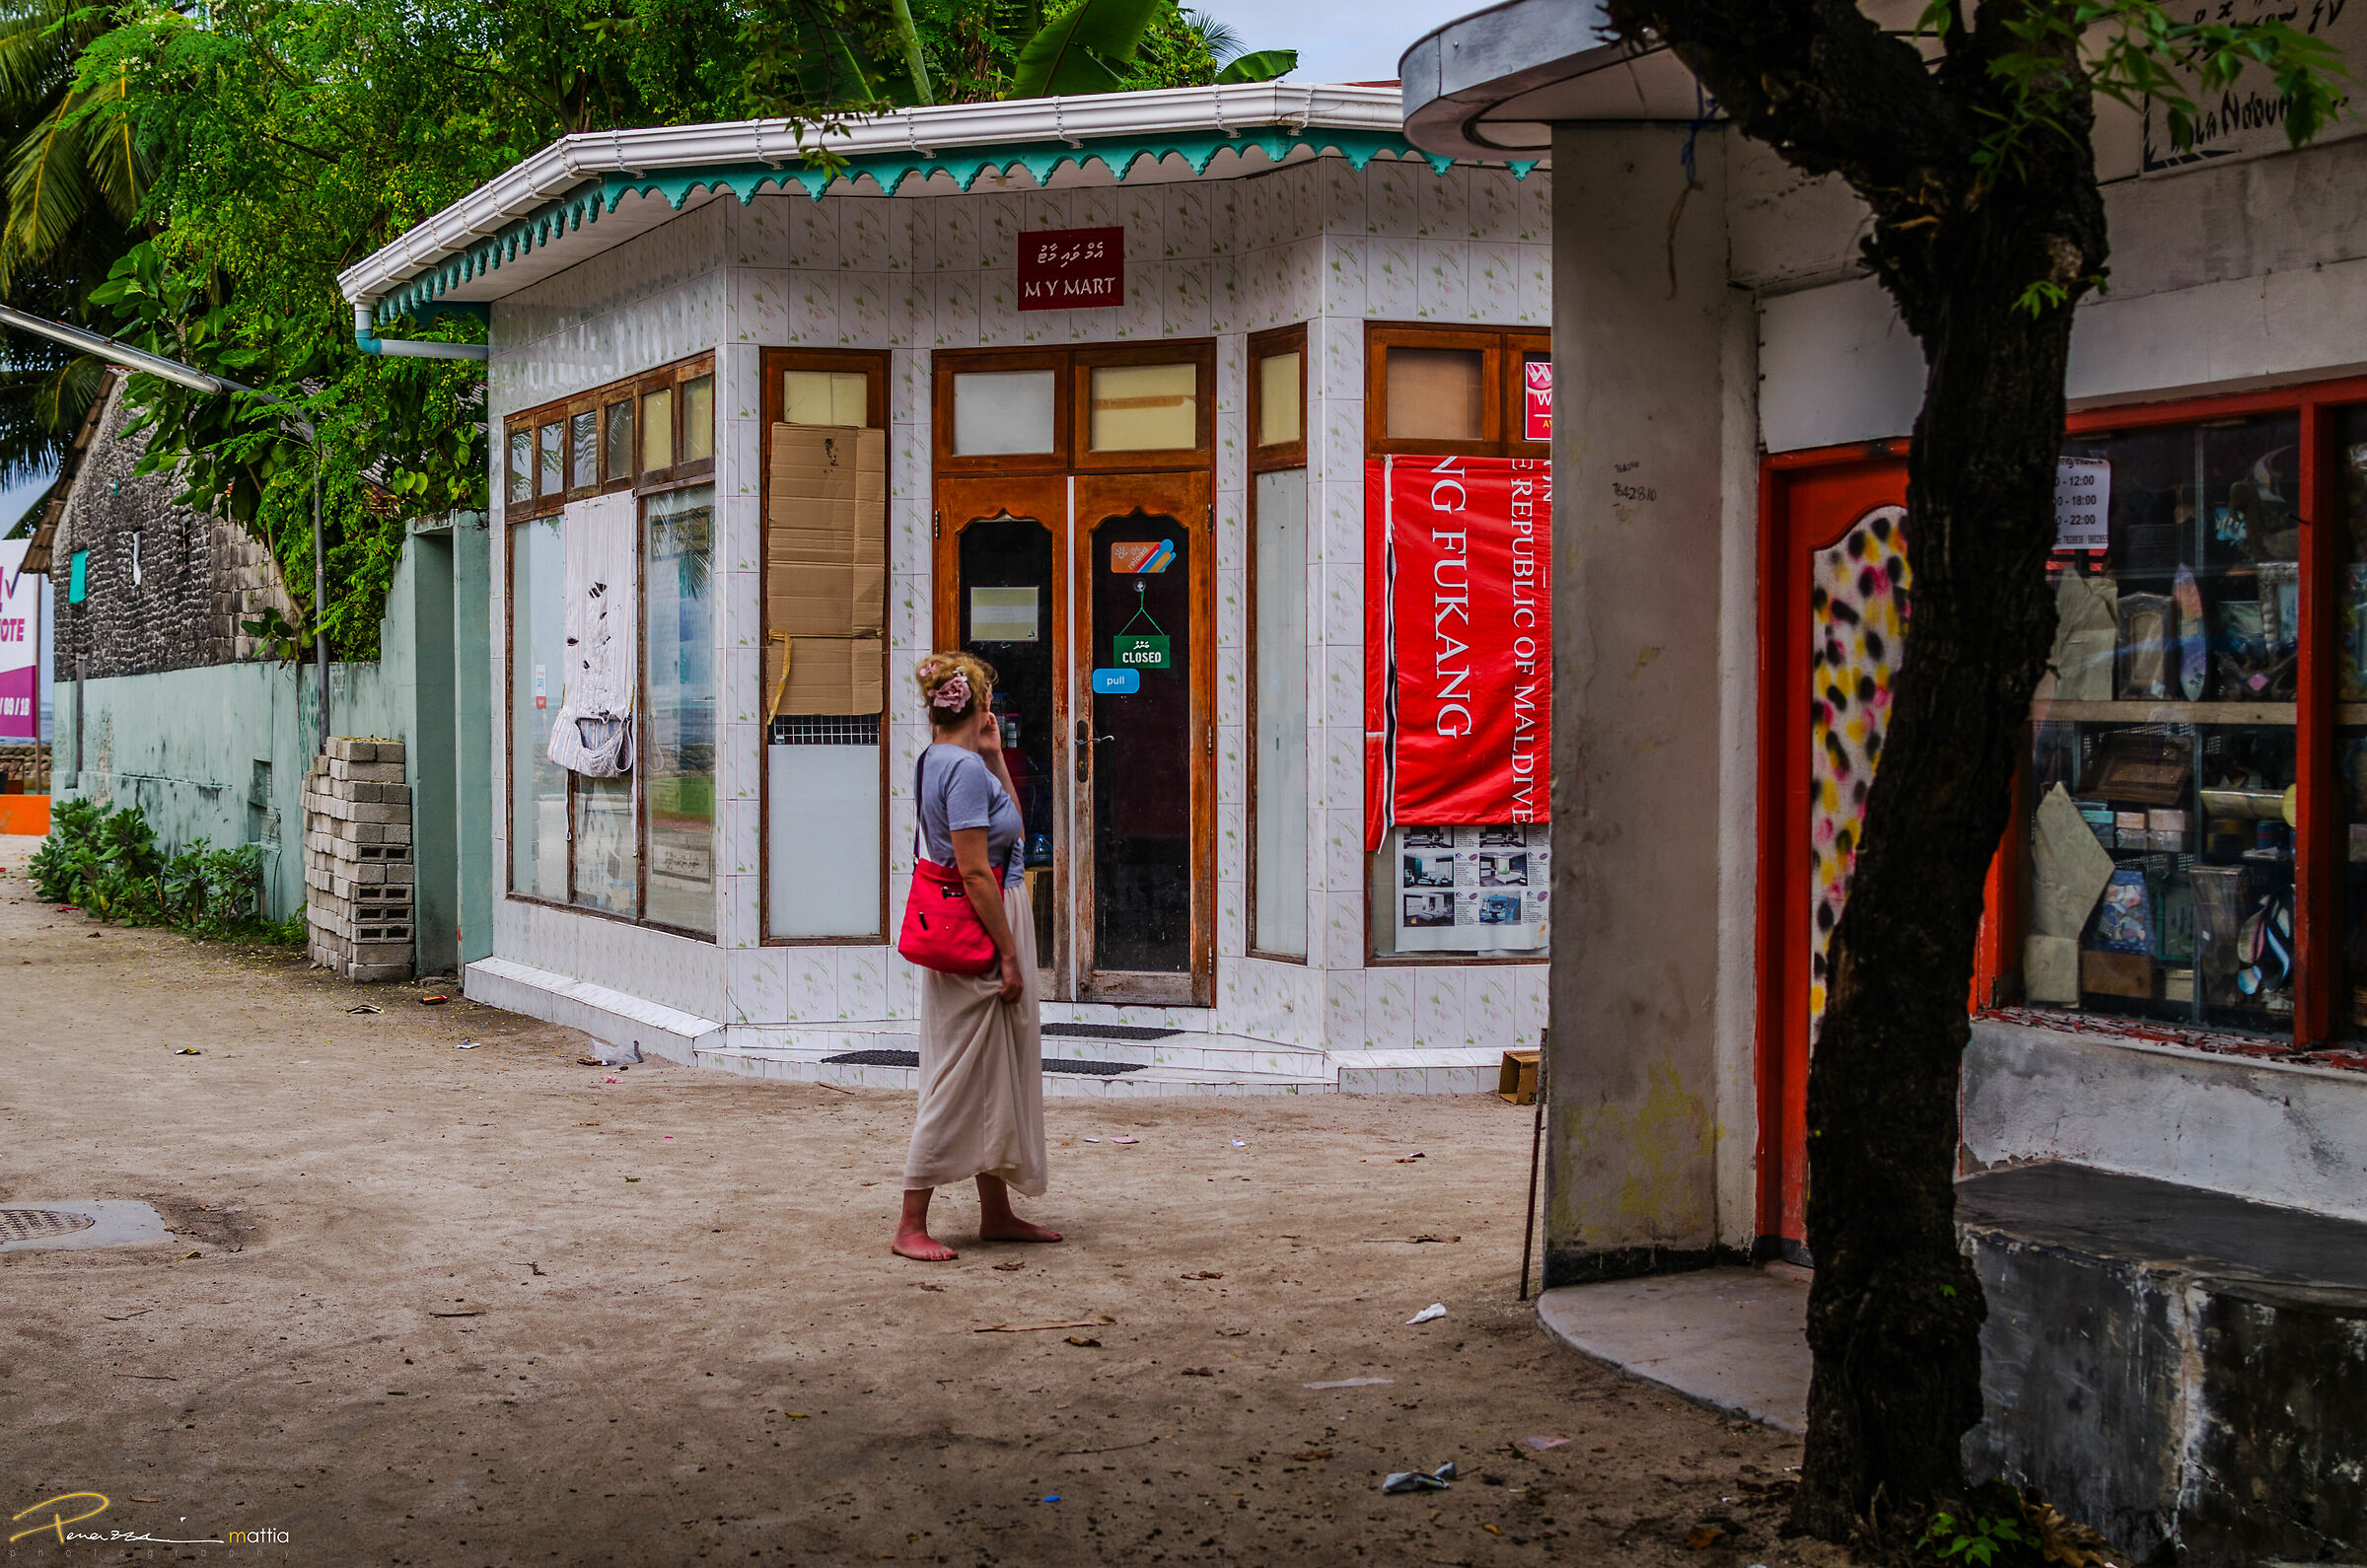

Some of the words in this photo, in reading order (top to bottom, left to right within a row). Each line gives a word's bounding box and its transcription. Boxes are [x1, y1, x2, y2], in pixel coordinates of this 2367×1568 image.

[1063, 276, 1115, 297] MART
[2069, 475, 2095, 486] 12:00
[2071, 495, 2097, 506] 18:00
[2069, 514, 2096, 526] 22:00
[1128, 545, 1150, 570] reload
[1510, 478, 1536, 628] REPUBLIC
[0, 618, 26, 642] OTE
[1431, 528, 1472, 740] FUKANG
[1121, 652, 1162, 664] CLOSED
[1513, 636, 1536, 676] OF
[1107, 676, 1125, 687] pull
[1511, 683, 1536, 824] MALDIVE
